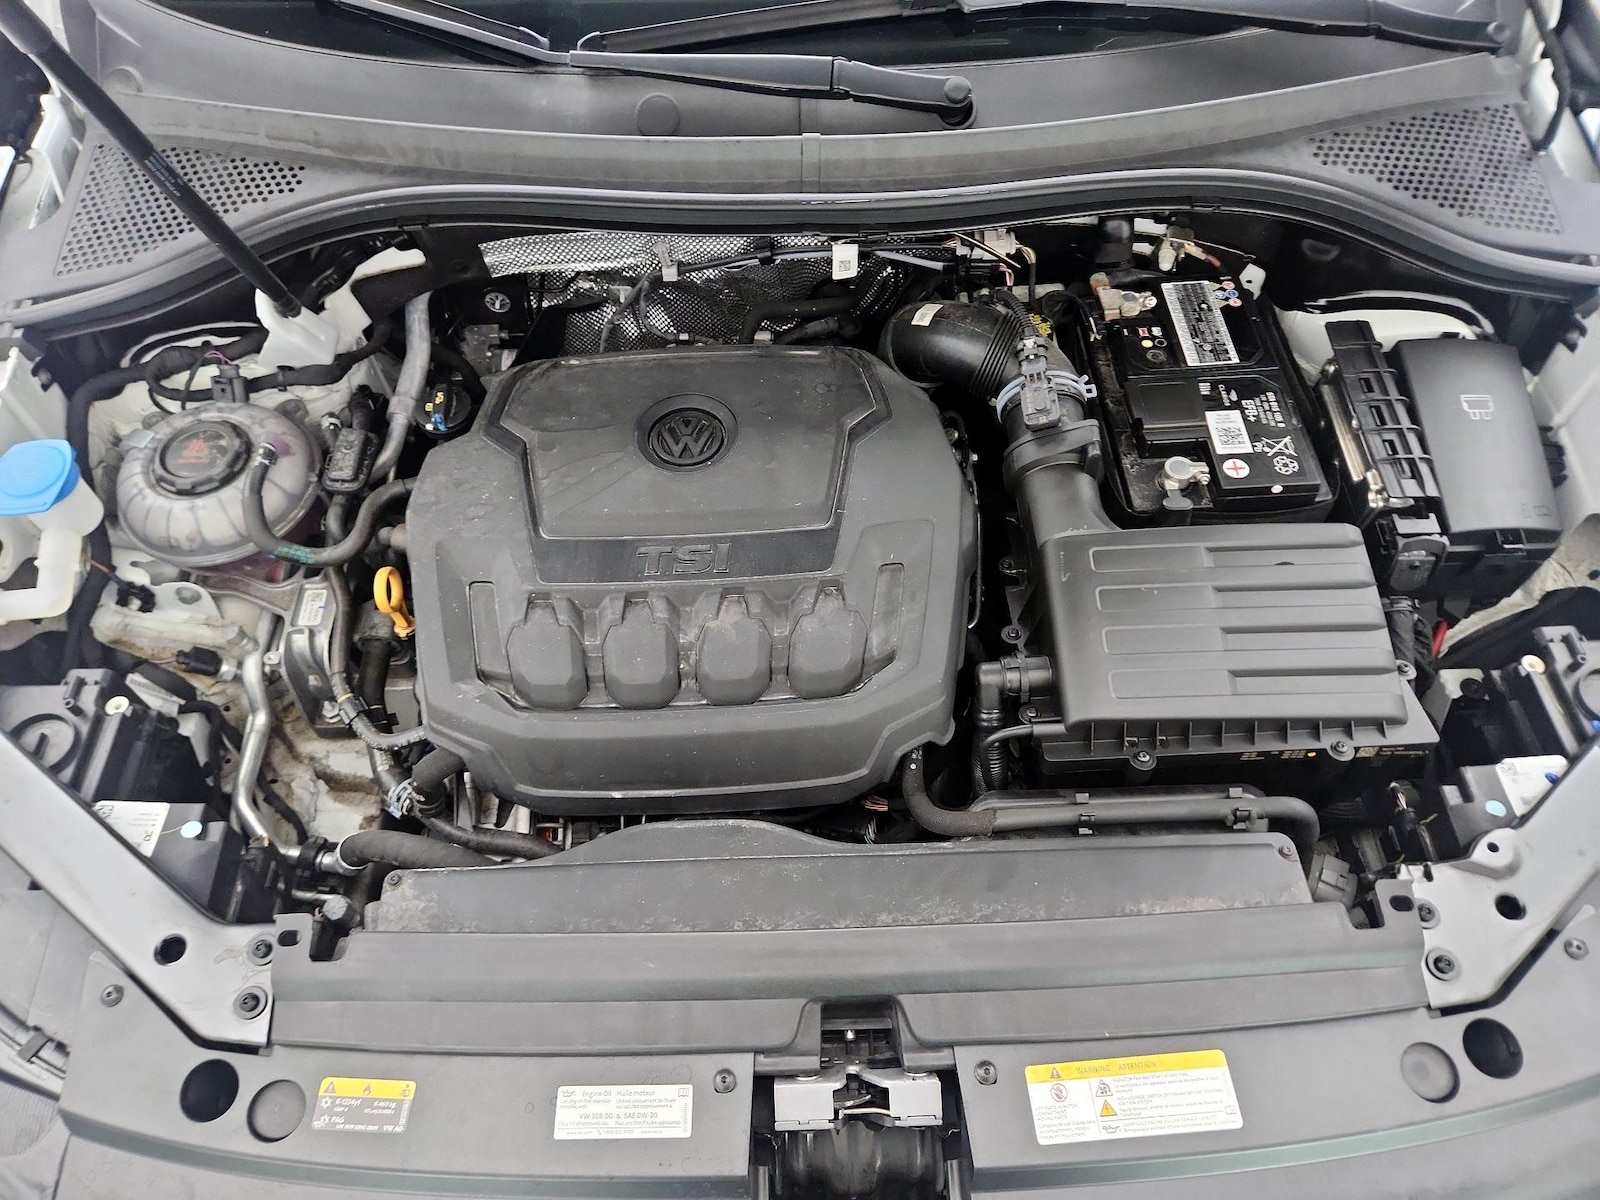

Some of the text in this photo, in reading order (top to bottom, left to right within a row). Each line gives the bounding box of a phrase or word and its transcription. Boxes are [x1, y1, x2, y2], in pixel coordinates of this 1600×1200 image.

[1241, 400, 1258, 422] EFB+
[653, 411, 722, 463] VW
[636, 543, 731, 575] TSI
[1075, 1060, 1157, 1074] WARNING ATTENTION
[582, 1090, 602, 1099] Engine
